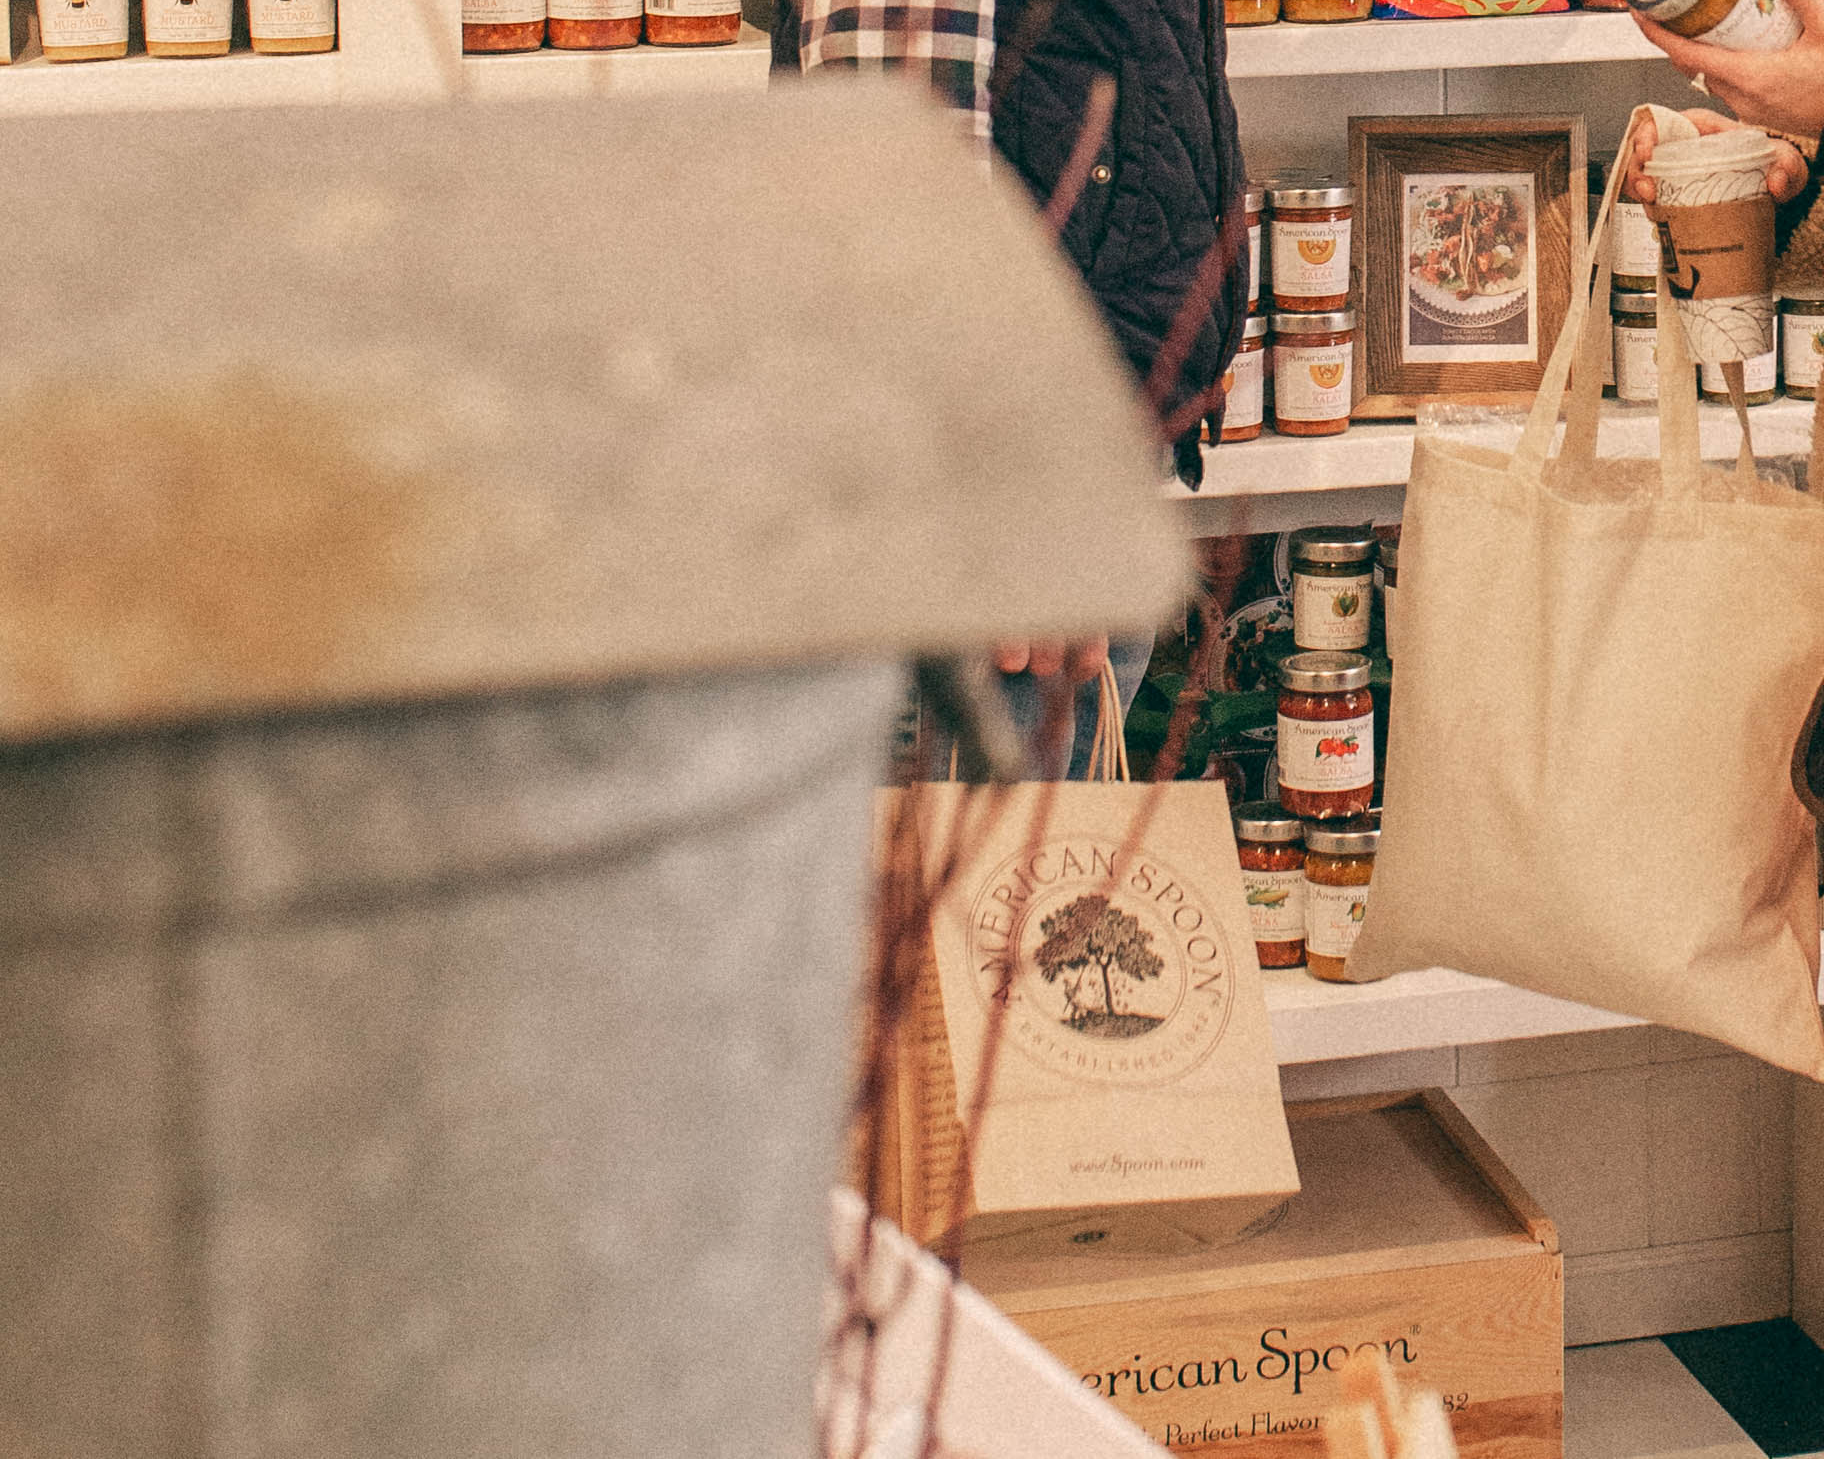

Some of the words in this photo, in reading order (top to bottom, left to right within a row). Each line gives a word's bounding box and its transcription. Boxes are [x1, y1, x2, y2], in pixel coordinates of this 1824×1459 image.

[160, 15, 215, 26] MUSTARD
[261, 12, 315, 22] MUSTARD
[54, 18, 108, 30] MUSTARD
[1279, 227, 1326, 237] American
[1300, 271, 1333, 280] SALSA
[1289, 351, 1337, 363] American
[1295, 723, 1344, 736] American
[1131, 863, 1222, 991] SPOON
[1081, 1354, 1248, 1398] erican
[1165, 1419, 1242, 1447] Perfect
[1250, 1412, 1326, 1437] Flavor
